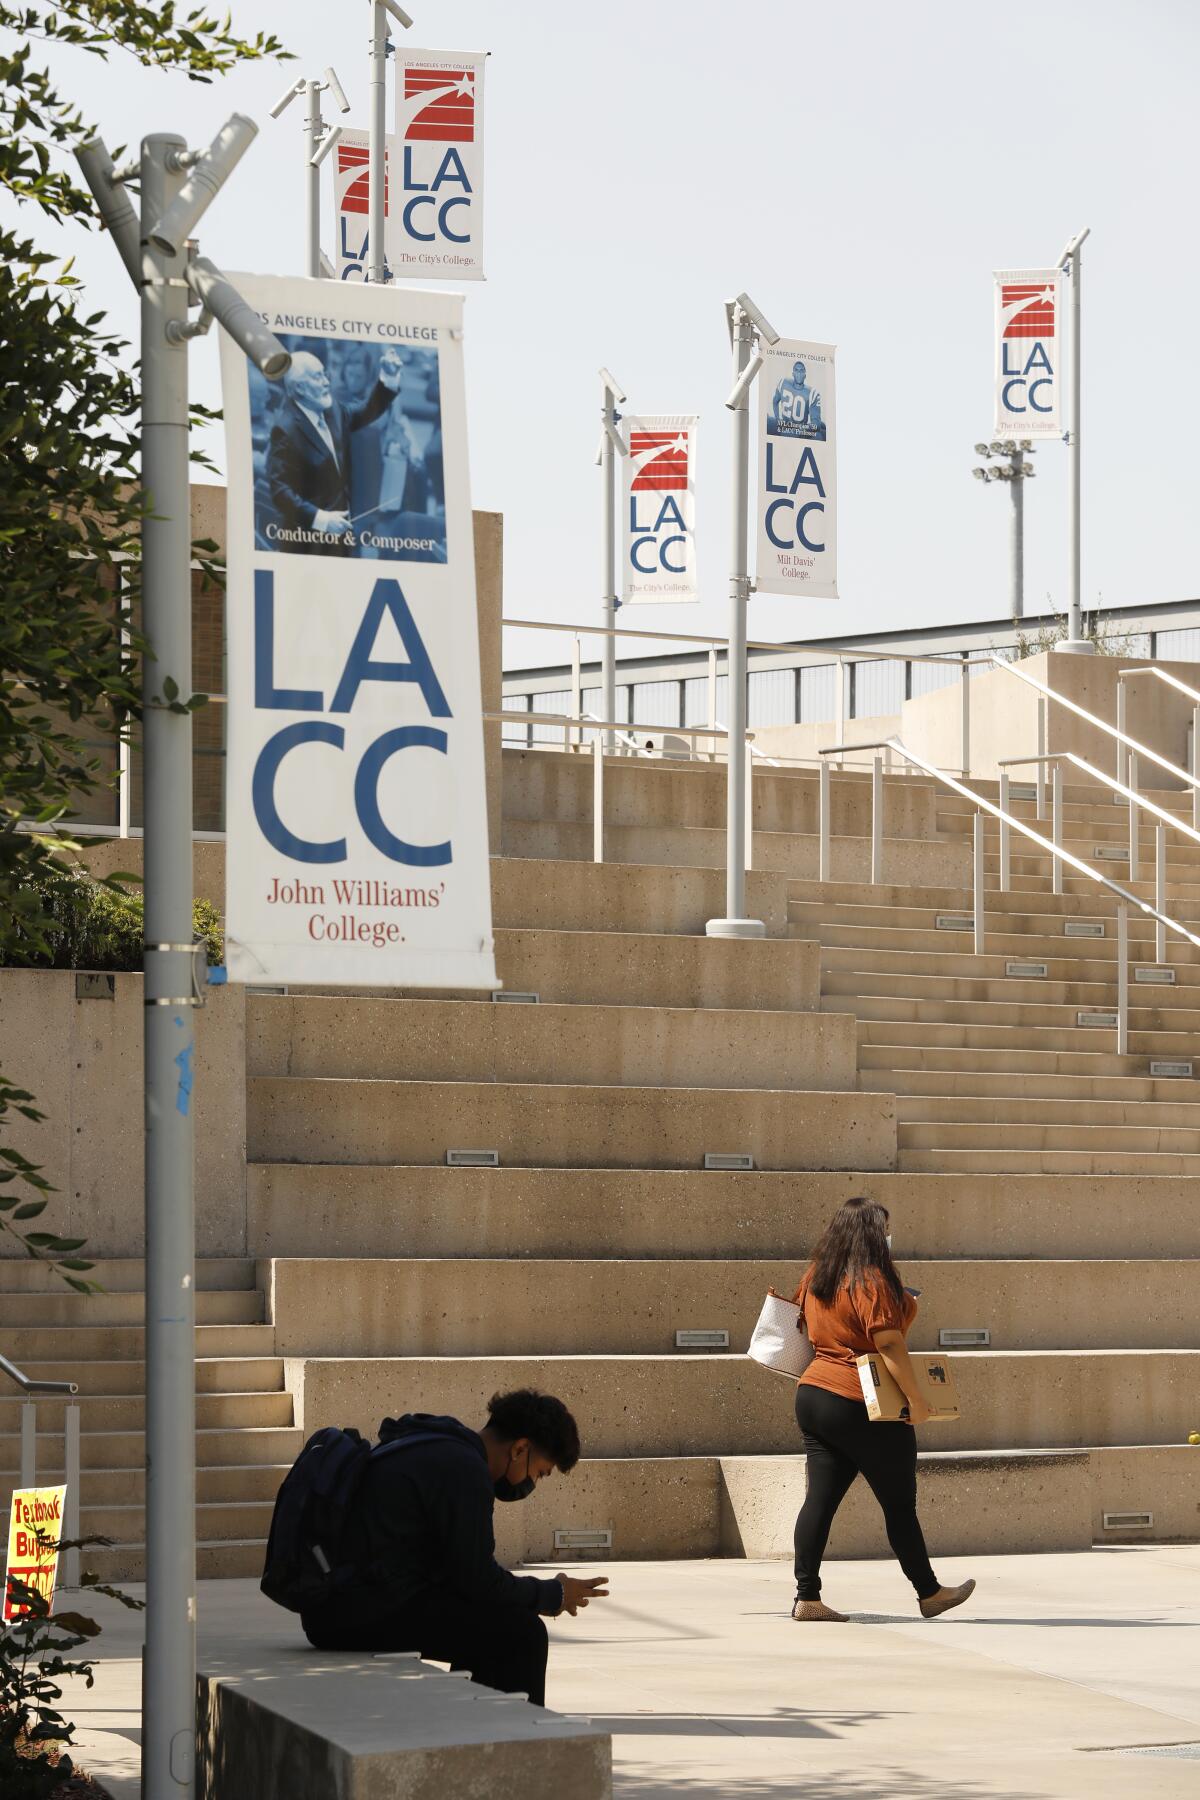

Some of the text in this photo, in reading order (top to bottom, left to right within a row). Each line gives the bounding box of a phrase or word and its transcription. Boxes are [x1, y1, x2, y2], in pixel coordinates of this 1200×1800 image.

[403, 145, 473, 193] LA
[402, 195, 471, 243] CC
[400, 253, 476, 267] The City's College.
[274, 314, 337, 333] ANGELES
[342, 319, 373, 335] CITY
[377, 323, 438, 341] COLLEGE
[1002, 342, 1054, 376] LA
[1002, 378, 1053, 413] CC
[766, 442, 826, 498] LA
[630, 495, 687, 533] LA
[765, 498, 825, 553] CC
[266, 523, 436, 552] Conductor & Composer
[630, 535, 686, 574] CC
[777, 554, 791, 565] Milt
[254, 569, 454, 718] LA
[252, 720, 453, 868] CC
[267, 878, 446, 909] John Williams'
[308, 914, 406, 948] College.
